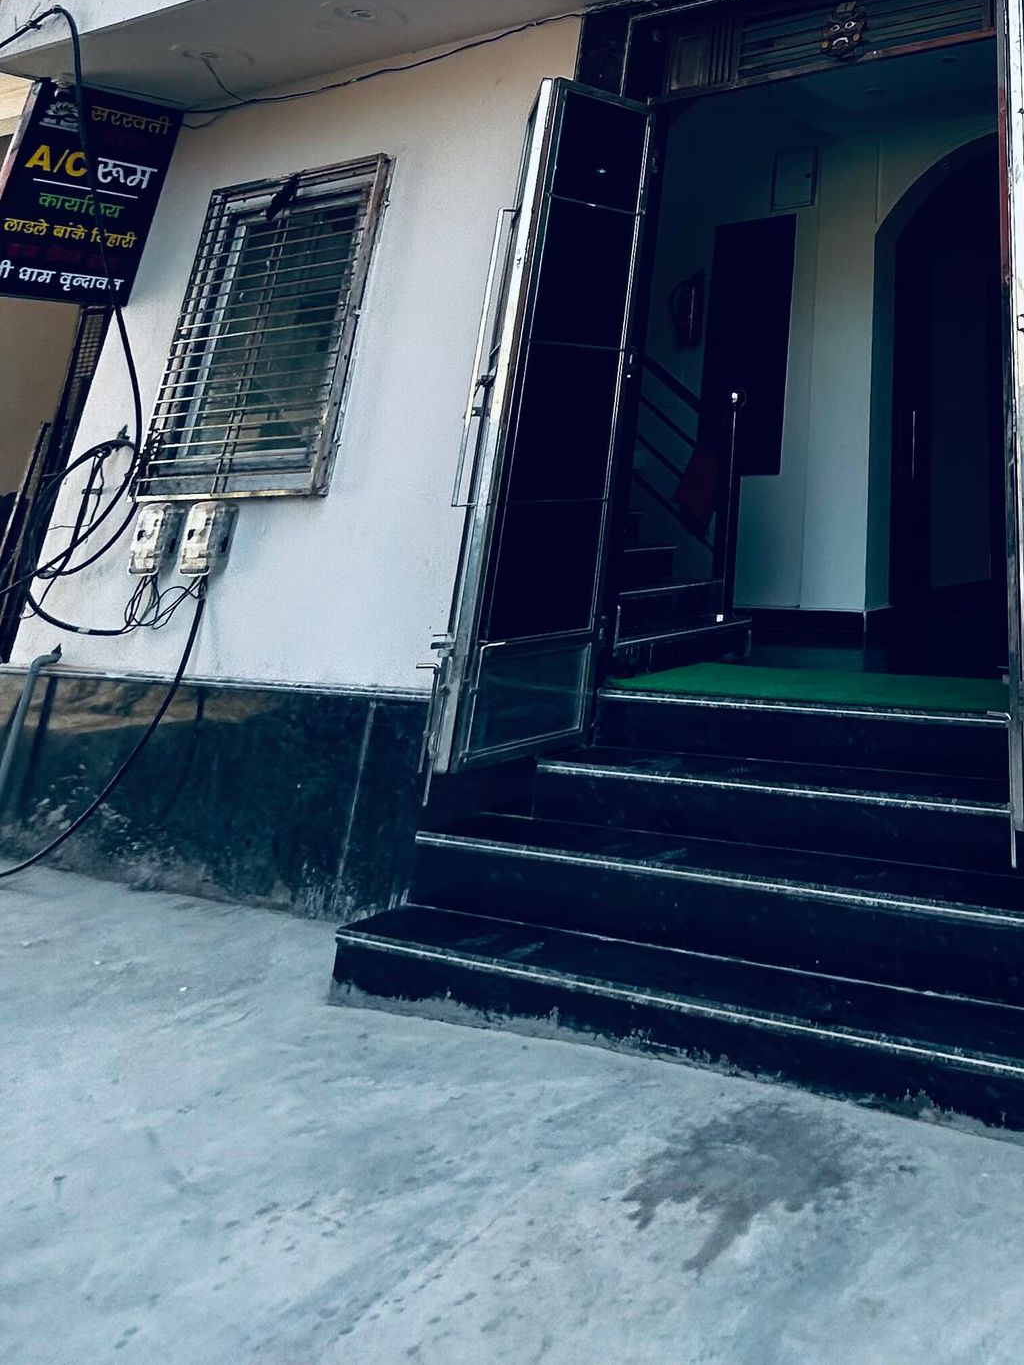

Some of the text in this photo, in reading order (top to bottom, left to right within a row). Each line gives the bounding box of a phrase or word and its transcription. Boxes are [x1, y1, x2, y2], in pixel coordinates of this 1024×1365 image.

[90, 105, 173, 135] सरस्वती
[24, 144, 158, 189] A/C रूम
[4, 217, 50, 236] लाडले
[53, 221, 88, 241] बांके
[18, 267, 57, 284] धाम
